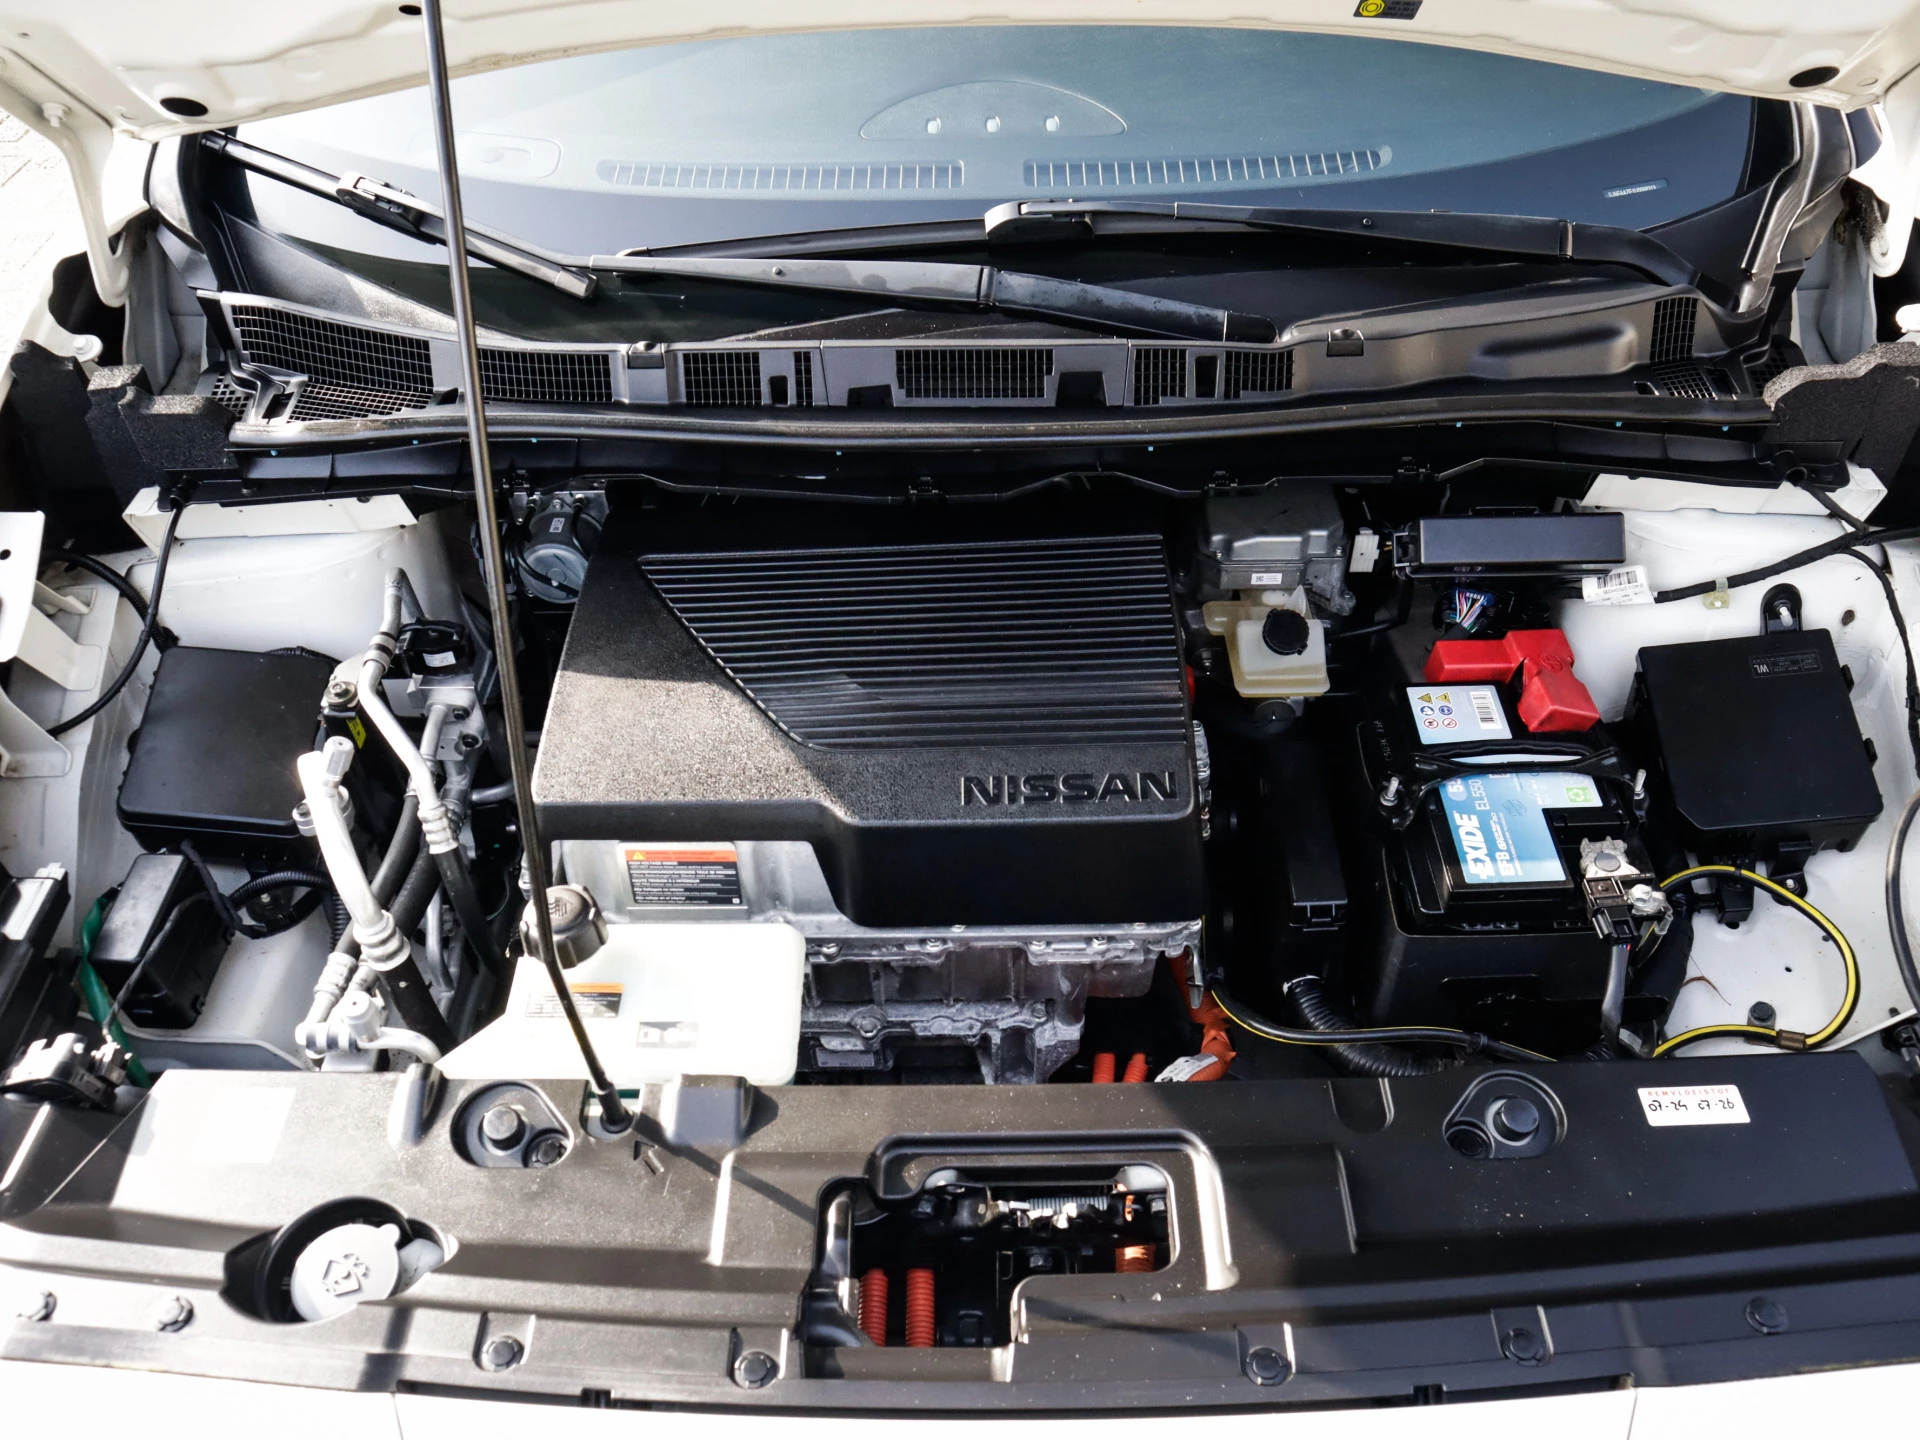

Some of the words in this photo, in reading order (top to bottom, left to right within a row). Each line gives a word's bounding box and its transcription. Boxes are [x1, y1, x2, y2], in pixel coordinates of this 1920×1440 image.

[1753, 664, 1770, 674] WL
[960, 770, 1179, 807] NISSAN
[1468, 779, 1491, 811] EL550
[1453, 811, 1496, 880] EXIDE
[1494, 851, 1516, 877] EFB
